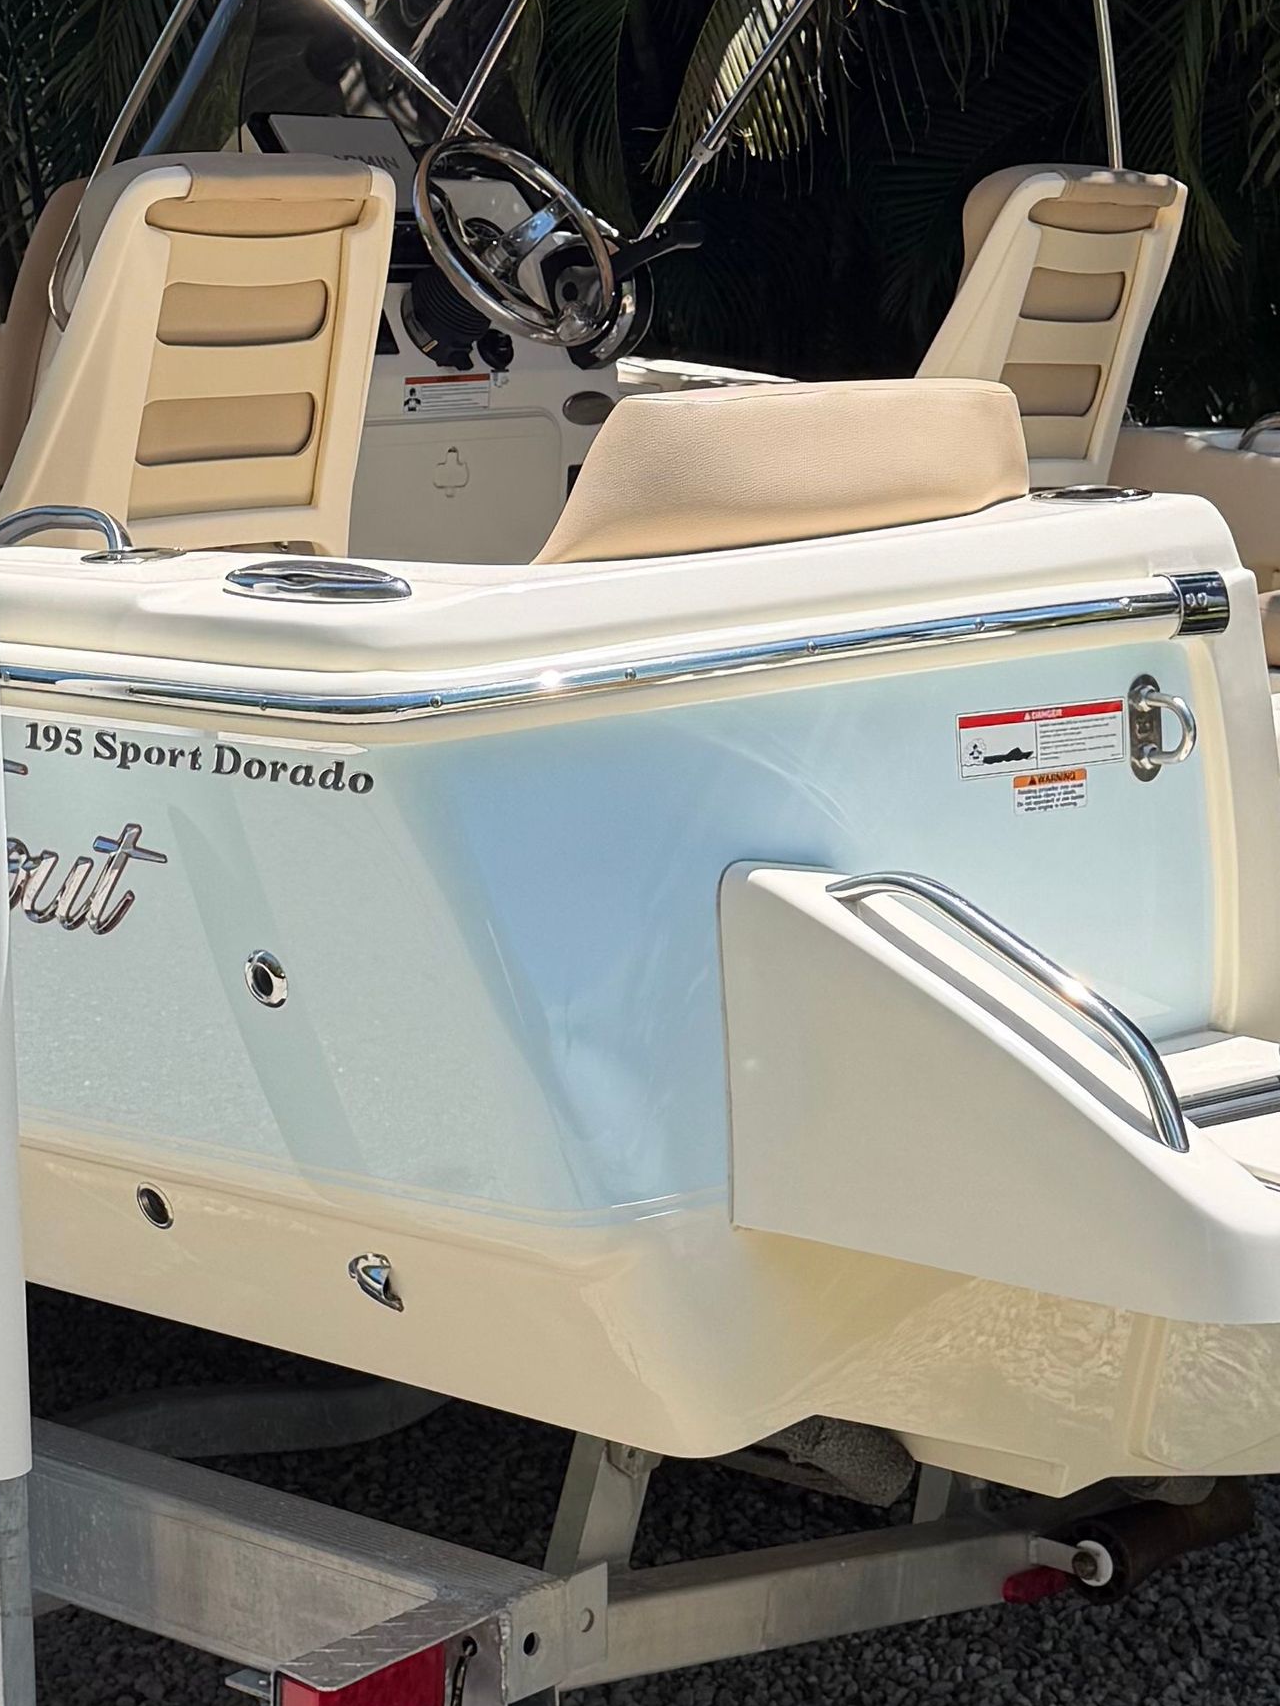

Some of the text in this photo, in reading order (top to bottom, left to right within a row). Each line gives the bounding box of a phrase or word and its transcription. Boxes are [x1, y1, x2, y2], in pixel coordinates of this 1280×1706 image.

[25, 721, 376, 795] 195 Sport Dorado
[1037, 770, 1076, 785] WARNING
